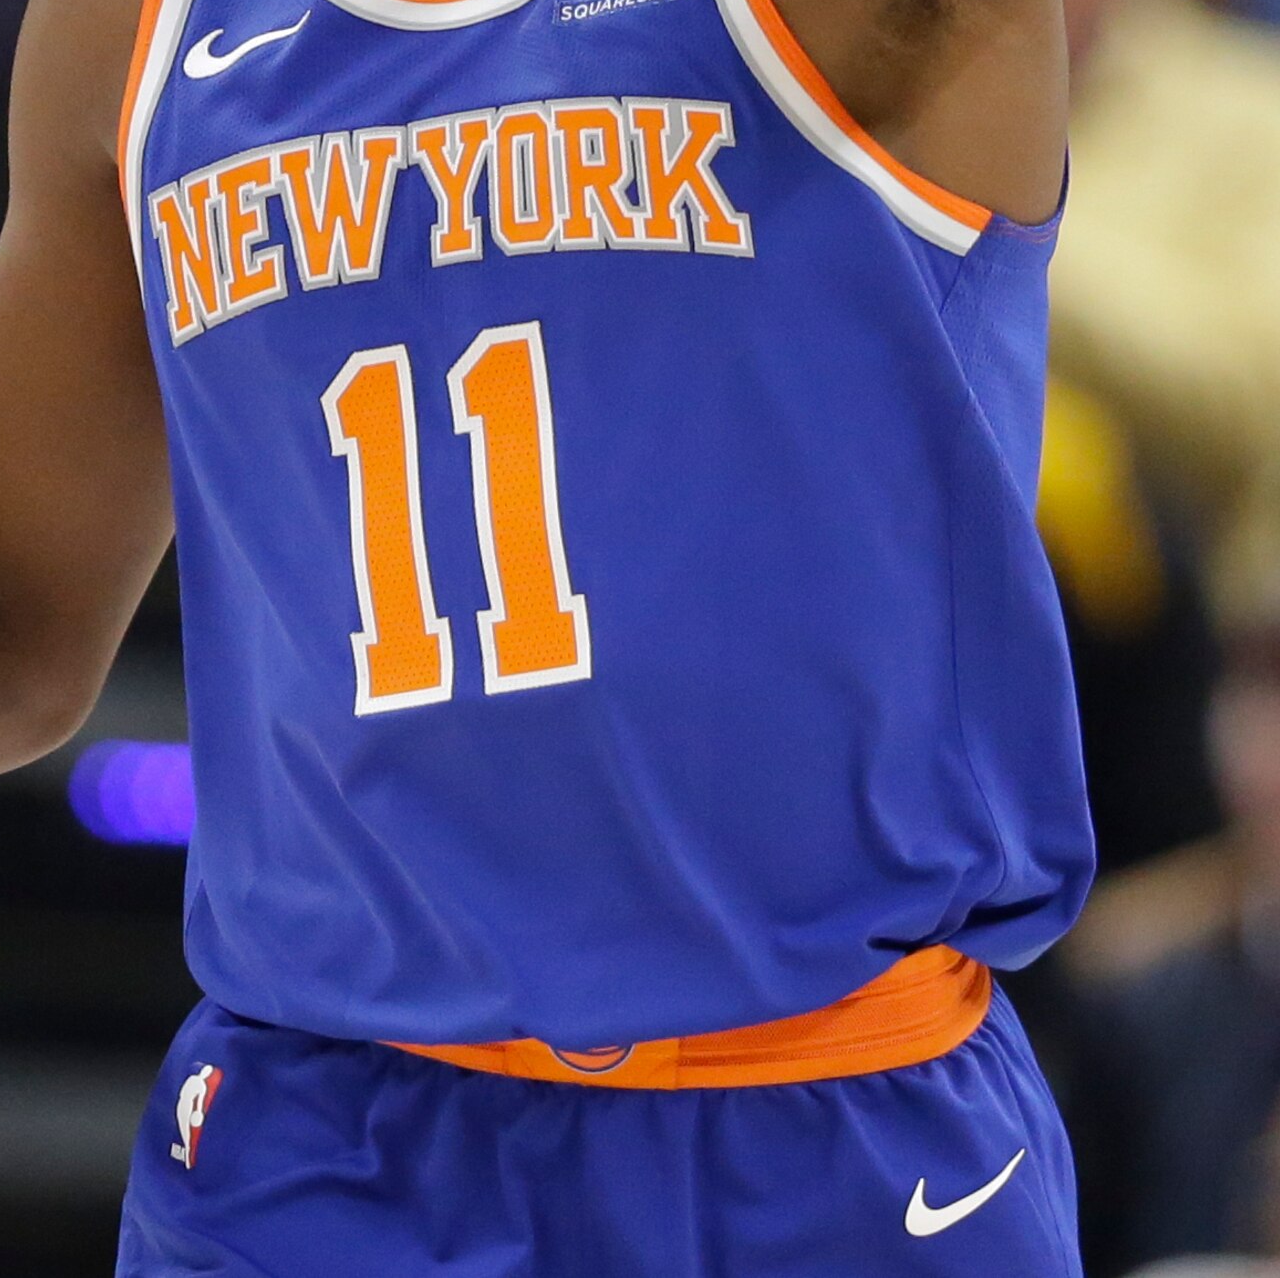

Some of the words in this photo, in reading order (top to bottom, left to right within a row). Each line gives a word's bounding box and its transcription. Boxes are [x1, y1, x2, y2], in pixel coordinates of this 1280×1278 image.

[148, 124, 408, 349] NEW
[408, 95, 755, 268] YORK
[320, 320, 592, 718] 11
